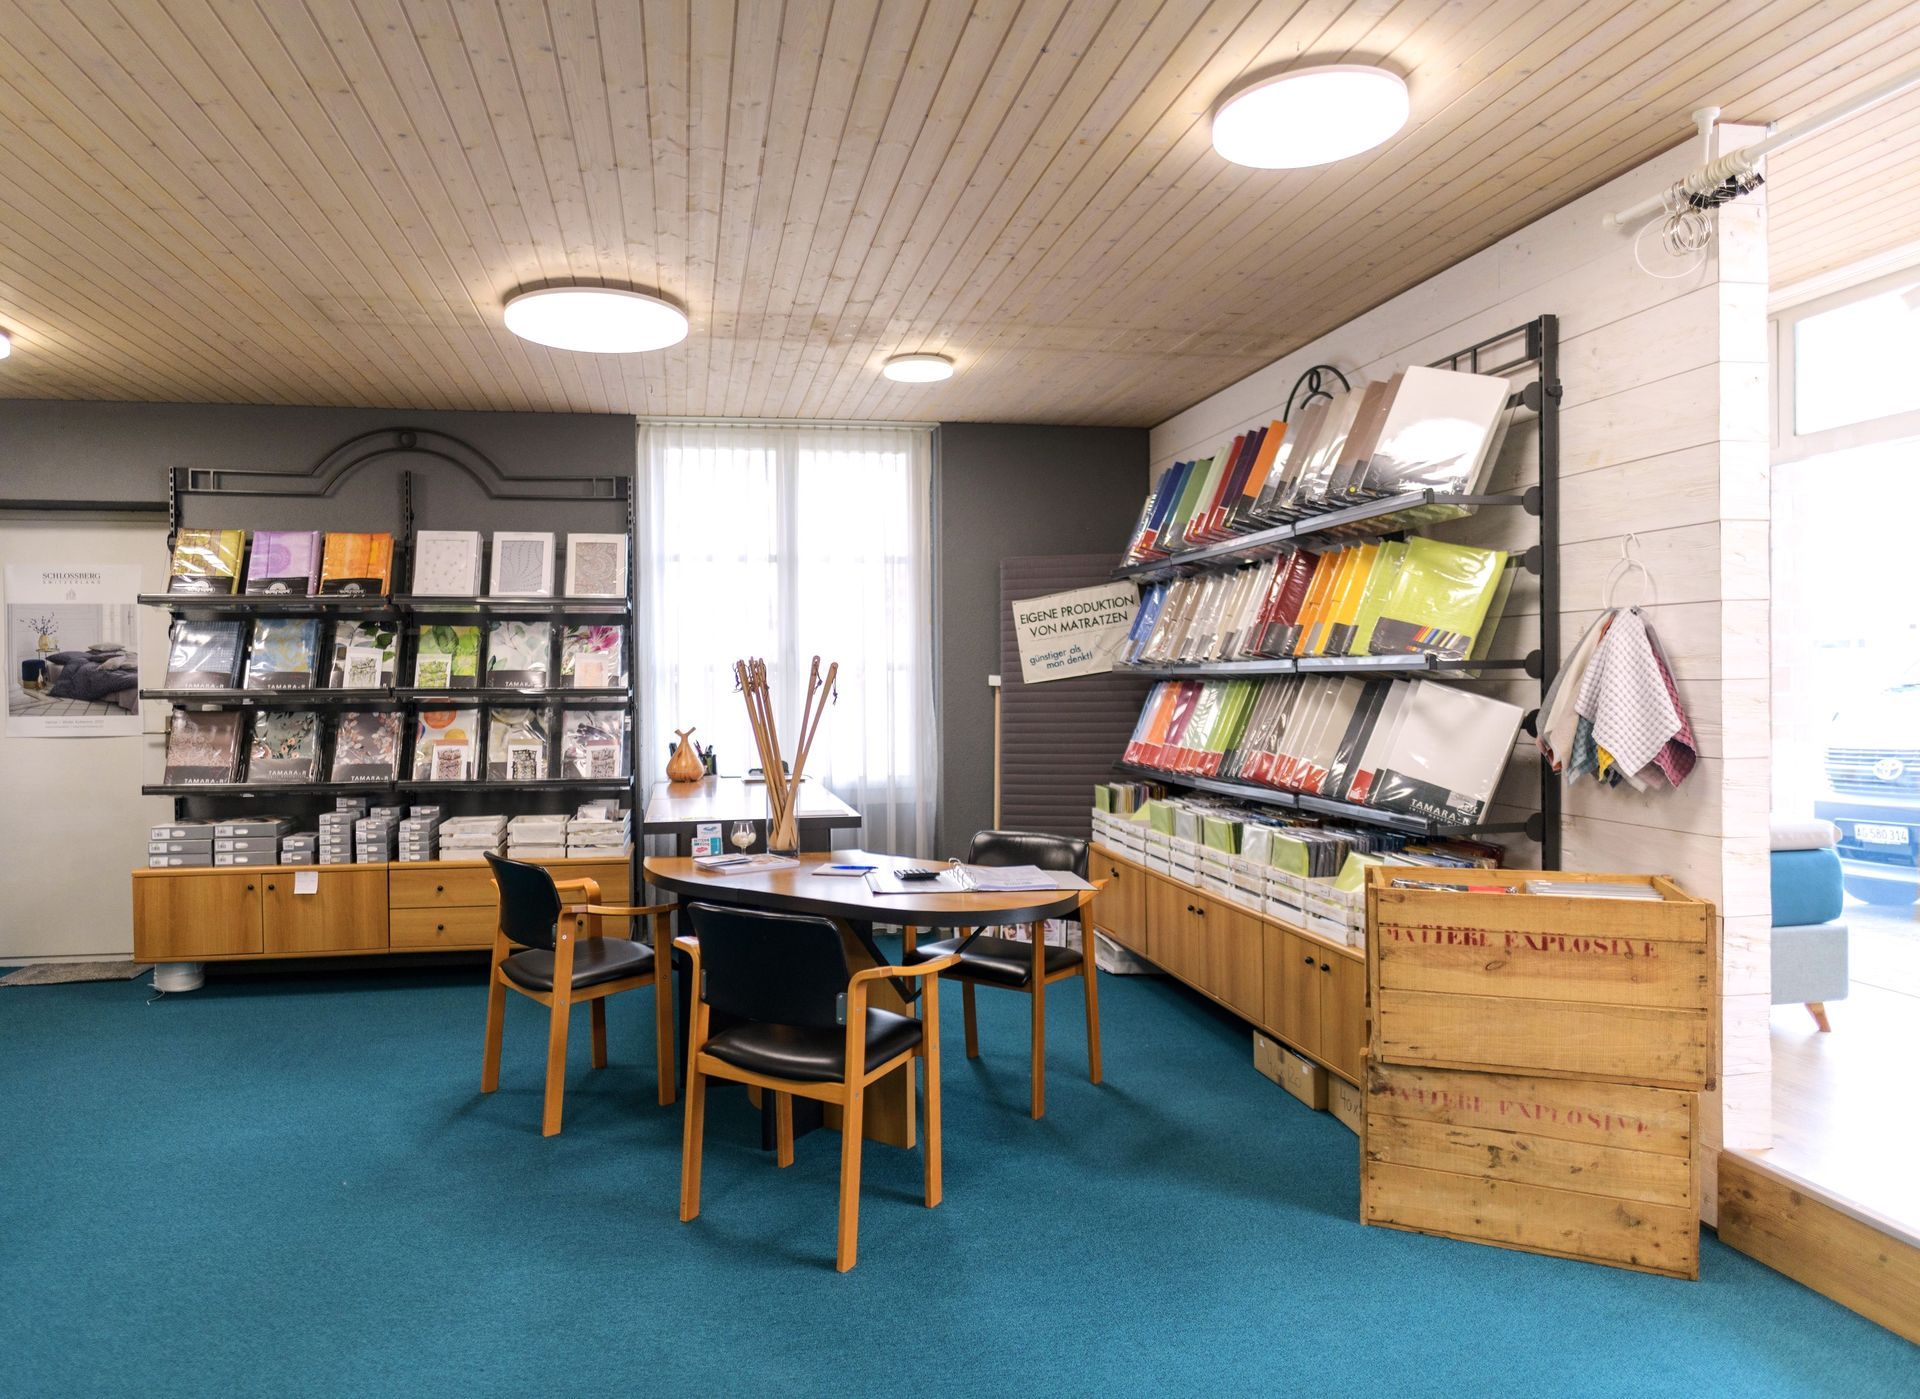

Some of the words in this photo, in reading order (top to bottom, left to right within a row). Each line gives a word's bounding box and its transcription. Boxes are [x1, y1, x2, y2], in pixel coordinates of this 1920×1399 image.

[42, 572, 101, 580] SCHLOSSBERG
[1020, 608, 1058, 625] EIGENE
[1061, 595, 1135, 617] PRODUKTION
[1029, 623, 1058, 638] VON
[1060, 611, 1128, 632] MATRATZEN
[1029, 649, 1067, 666] günstiger
[1069, 644, 1082, 655] als
[1046, 659, 1065, 670] man
[1067, 652, 1093, 666] denkt!
[1505, 930, 1659, 959] EXPLOSIVE
[1500, 1100, 1651, 1135] EXPLOSIVE
